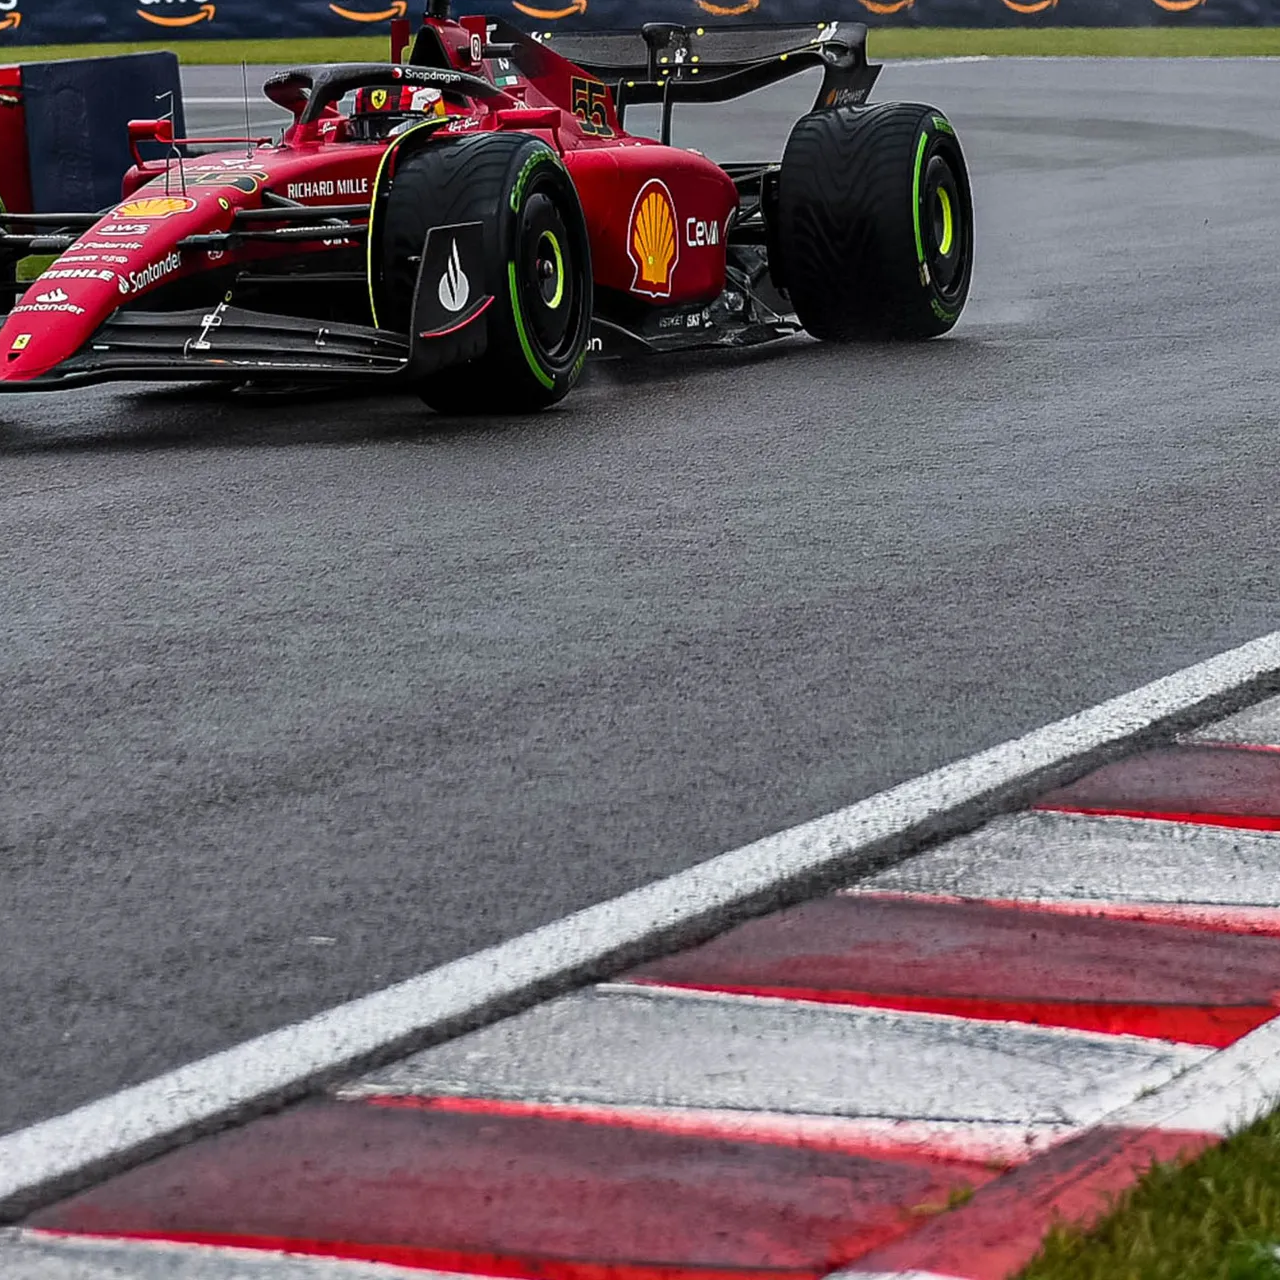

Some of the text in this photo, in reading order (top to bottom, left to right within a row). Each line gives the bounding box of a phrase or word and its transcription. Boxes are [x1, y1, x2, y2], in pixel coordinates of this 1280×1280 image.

[405, 69, 461, 84] Snapdragon
[571, 76, 615, 137] 55
[287, 178, 368, 199] RICHARD MILLE
[129, 250, 181, 293] Santander
